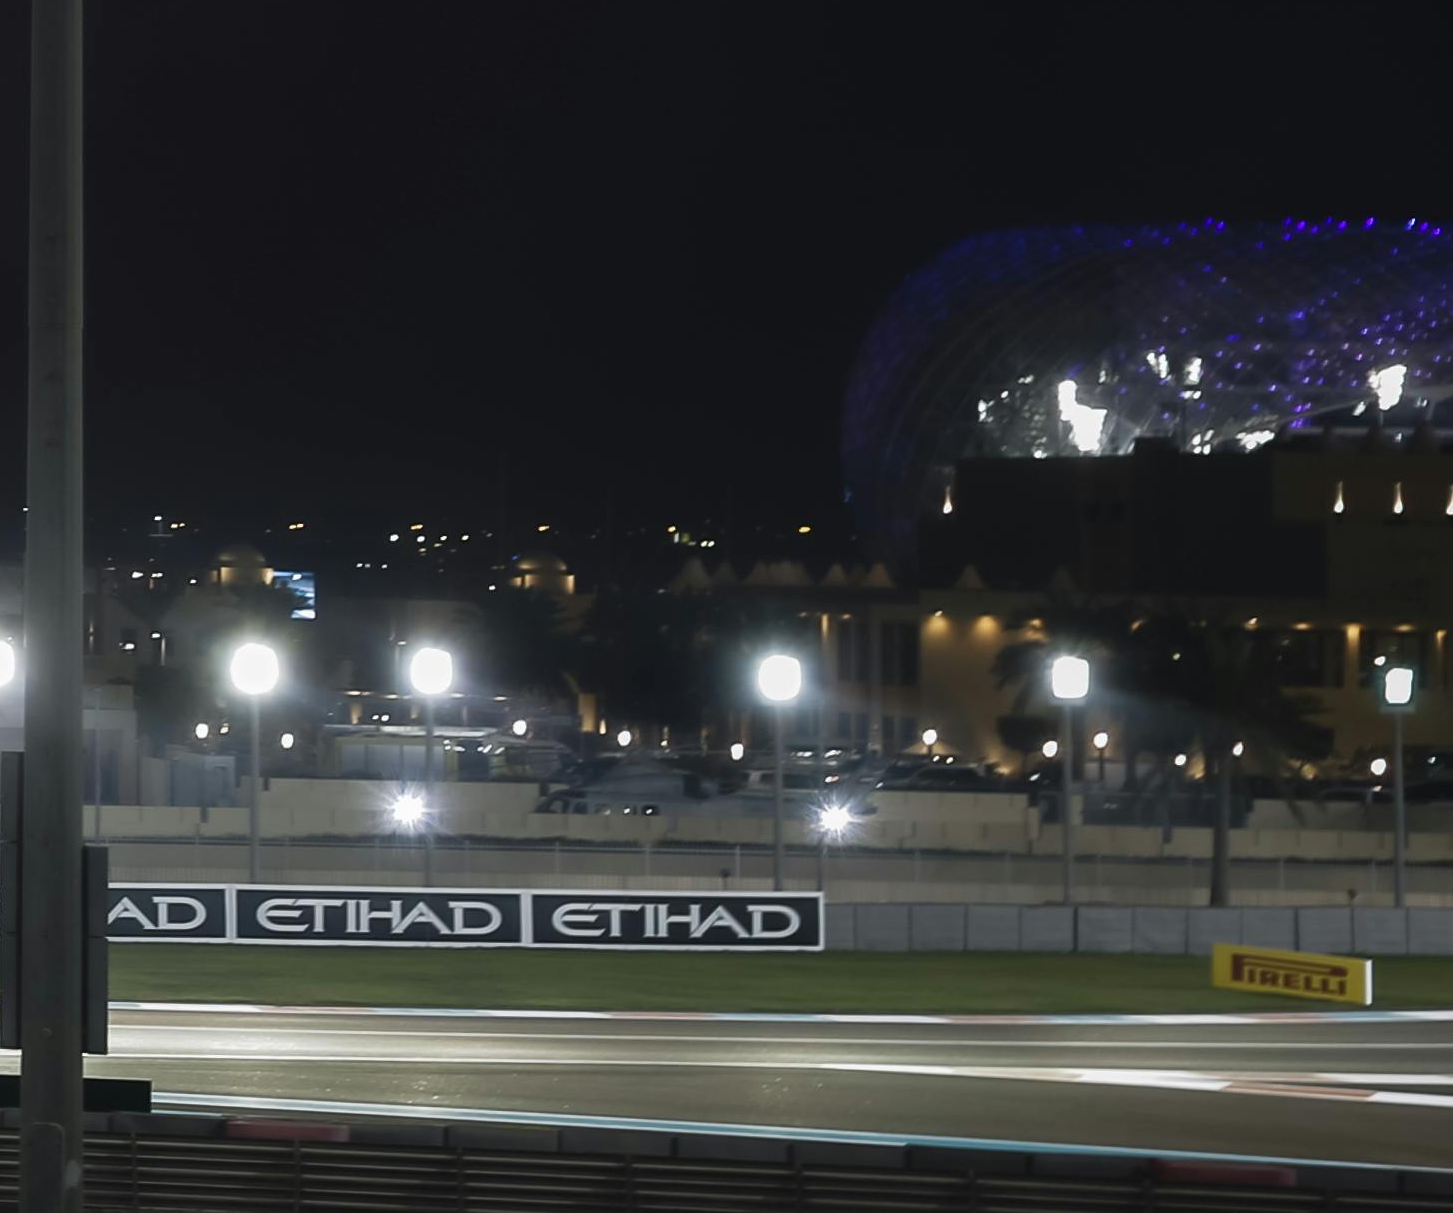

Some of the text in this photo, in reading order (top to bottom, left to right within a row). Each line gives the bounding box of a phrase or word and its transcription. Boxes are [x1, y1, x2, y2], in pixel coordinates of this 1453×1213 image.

[255, 897, 503, 935] ETIHAD
[551, 902, 801, 938] ETIHAD
[1231, 953, 1349, 996] PIRELLI
